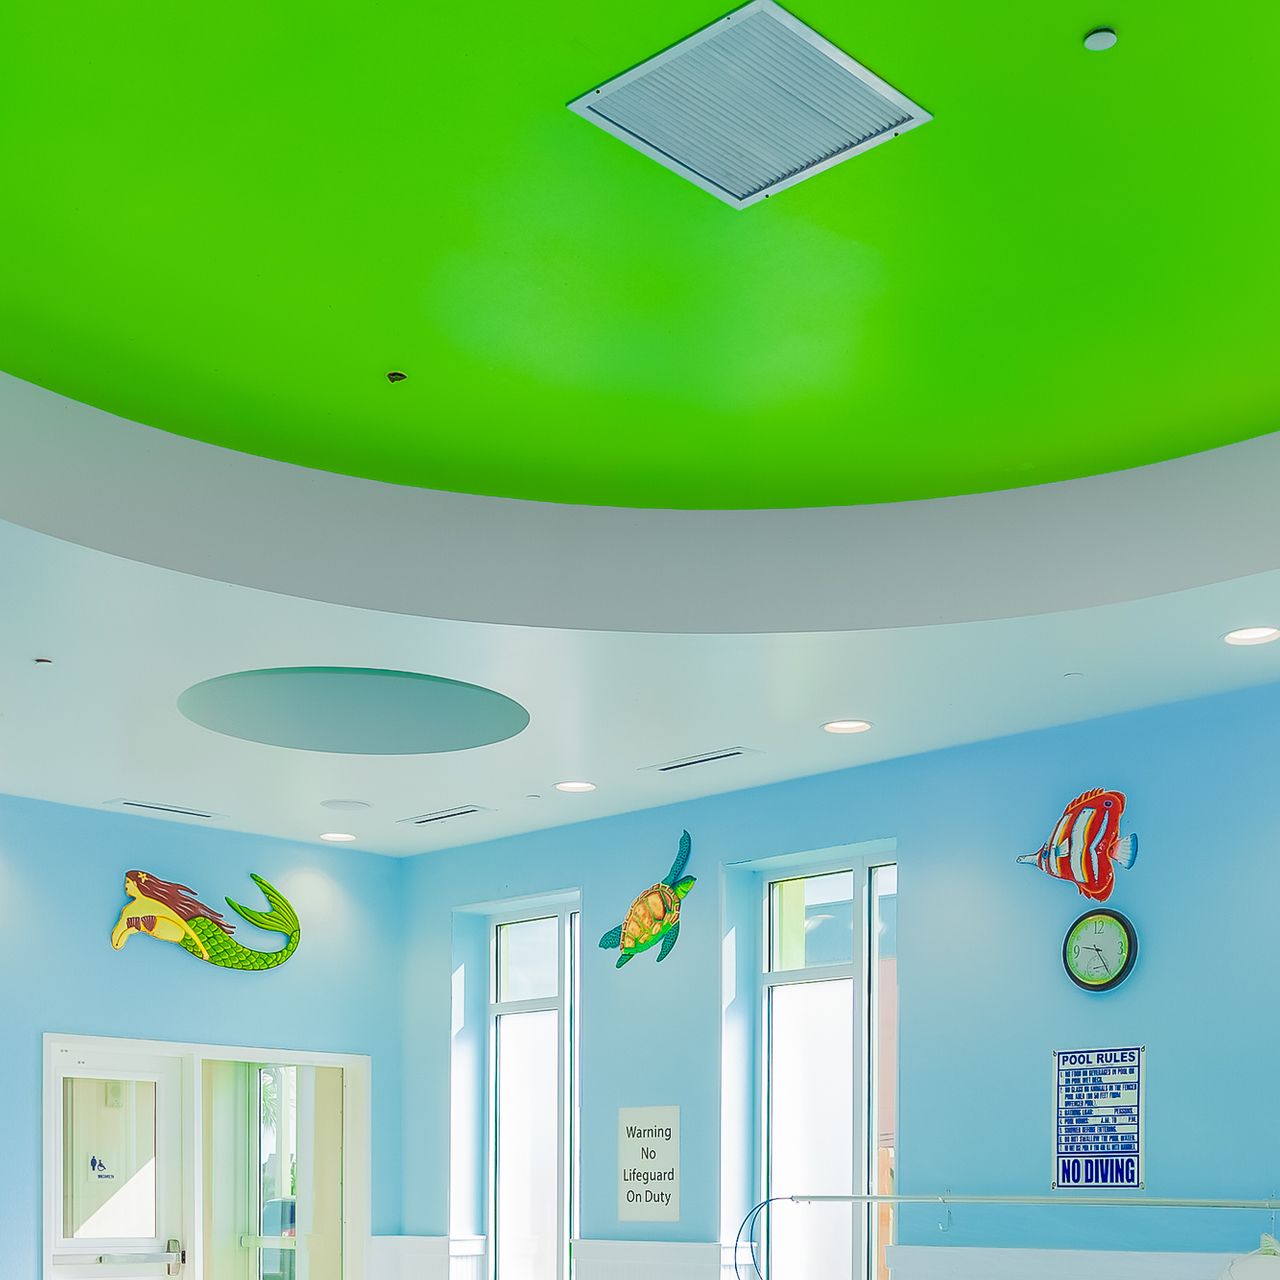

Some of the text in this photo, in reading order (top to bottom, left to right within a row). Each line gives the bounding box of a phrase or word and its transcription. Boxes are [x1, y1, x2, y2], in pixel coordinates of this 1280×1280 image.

[1094, 920, 1105, 935] 12
[1073, 944, 1081, 959] 9
[1062, 1051, 1136, 1065] POOL RULES
[625, 1125, 672, 1141] Warning
[641, 1146, 657, 1160] No
[623, 1167, 675, 1185] Lifeguard
[1061, 1157, 1135, 1184] NO DIVING
[626, 1189, 672, 1206] On Duty
